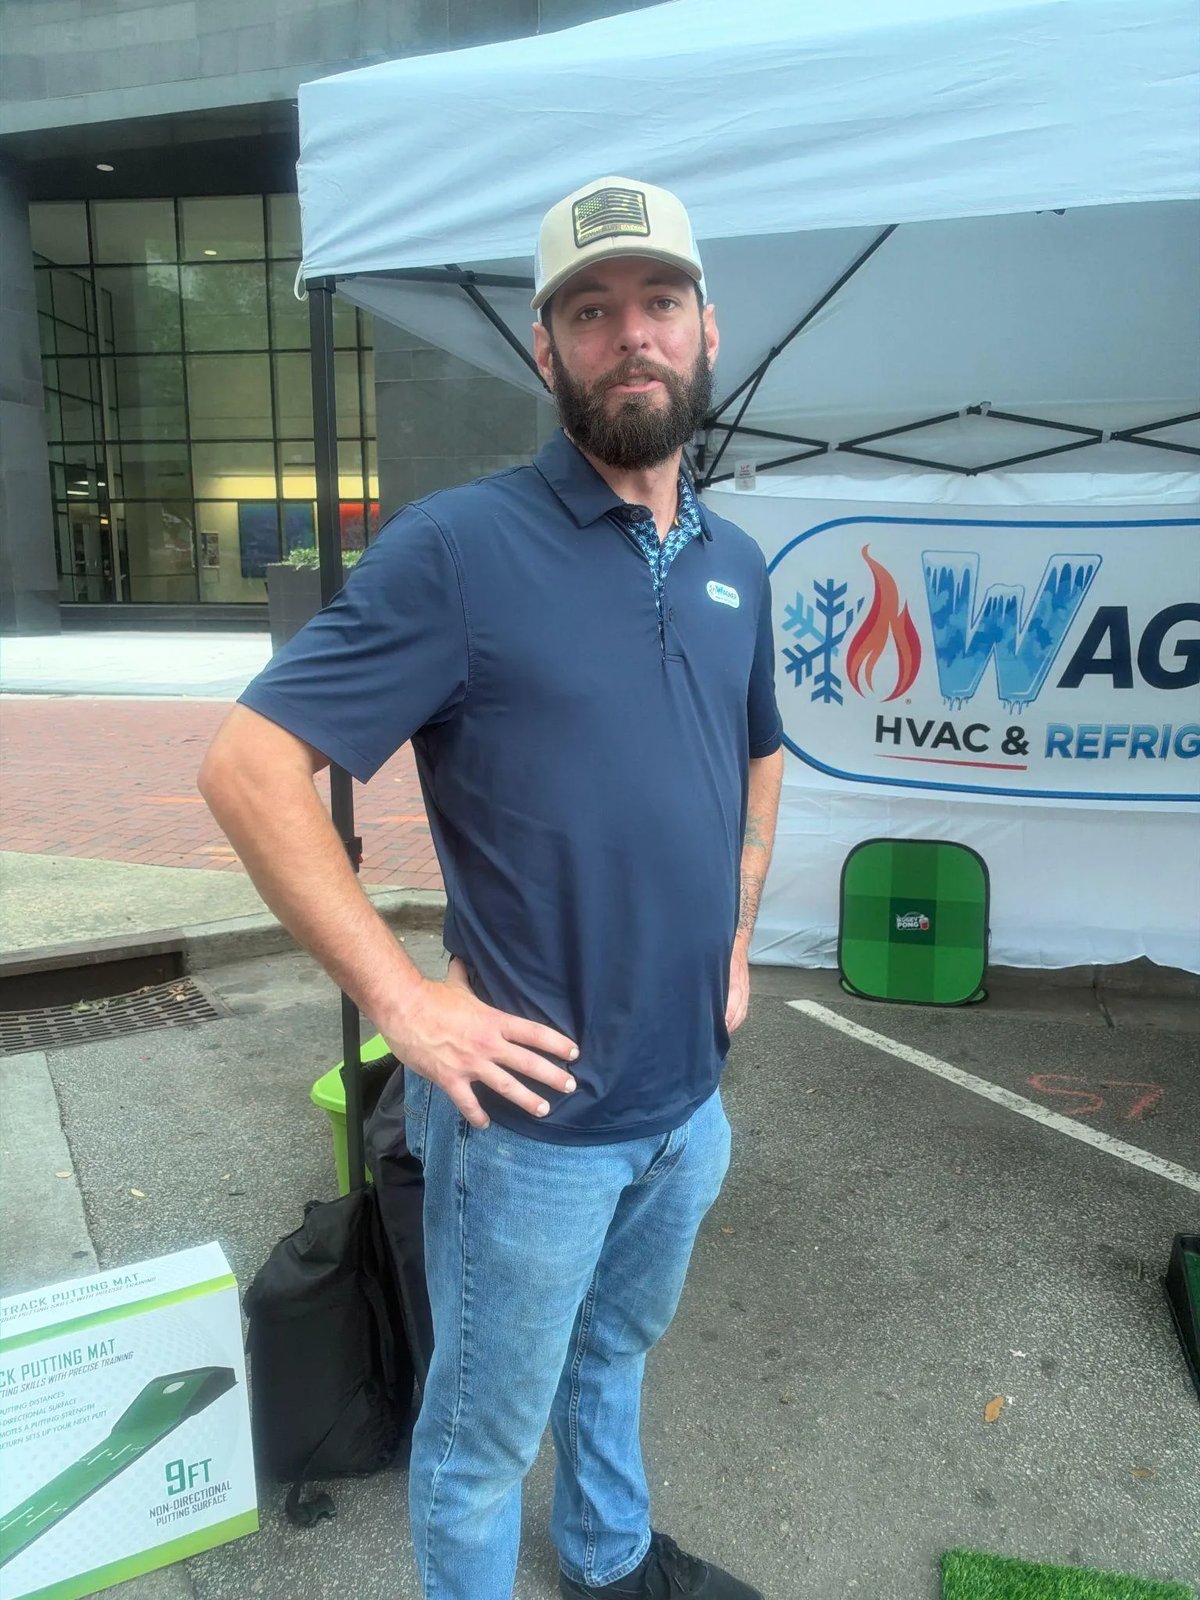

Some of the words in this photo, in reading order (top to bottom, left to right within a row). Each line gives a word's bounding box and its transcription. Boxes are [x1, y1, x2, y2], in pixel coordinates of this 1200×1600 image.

[875, 714, 990, 754] HVAC
[1001, 725, 1030, 755] &
[2, 1297, 47, 1316] TRACK
[52, 1281, 108, 1303] PUTTING
[113, 1273, 139, 1287] MAT
[20, 1377, 47, 1393] SKILLS
[48, 1371, 68, 1384] WITH
[69, 1360, 100, 1378] PRECISE
[101, 1350, 134, 1368] TRAINING
[21, 1348, 83, 1381] PUTTING
[88, 1338, 115, 1361] MAT
[29, 1391, 66, 1407] DISTANCES
[31, 1415, 61, 1429] PUTTING
[61, 1403, 96, 1419] STRENGTH
[49, 1398, 77, 1412] SURFACE
[165, 1457, 213, 1497] 9FT
[149, 1480, 232, 1519] NON-DIRECTIONAL
[156, 1506, 190, 1527] PUTTING
[191, 1492, 228, 1515] SURFACE
